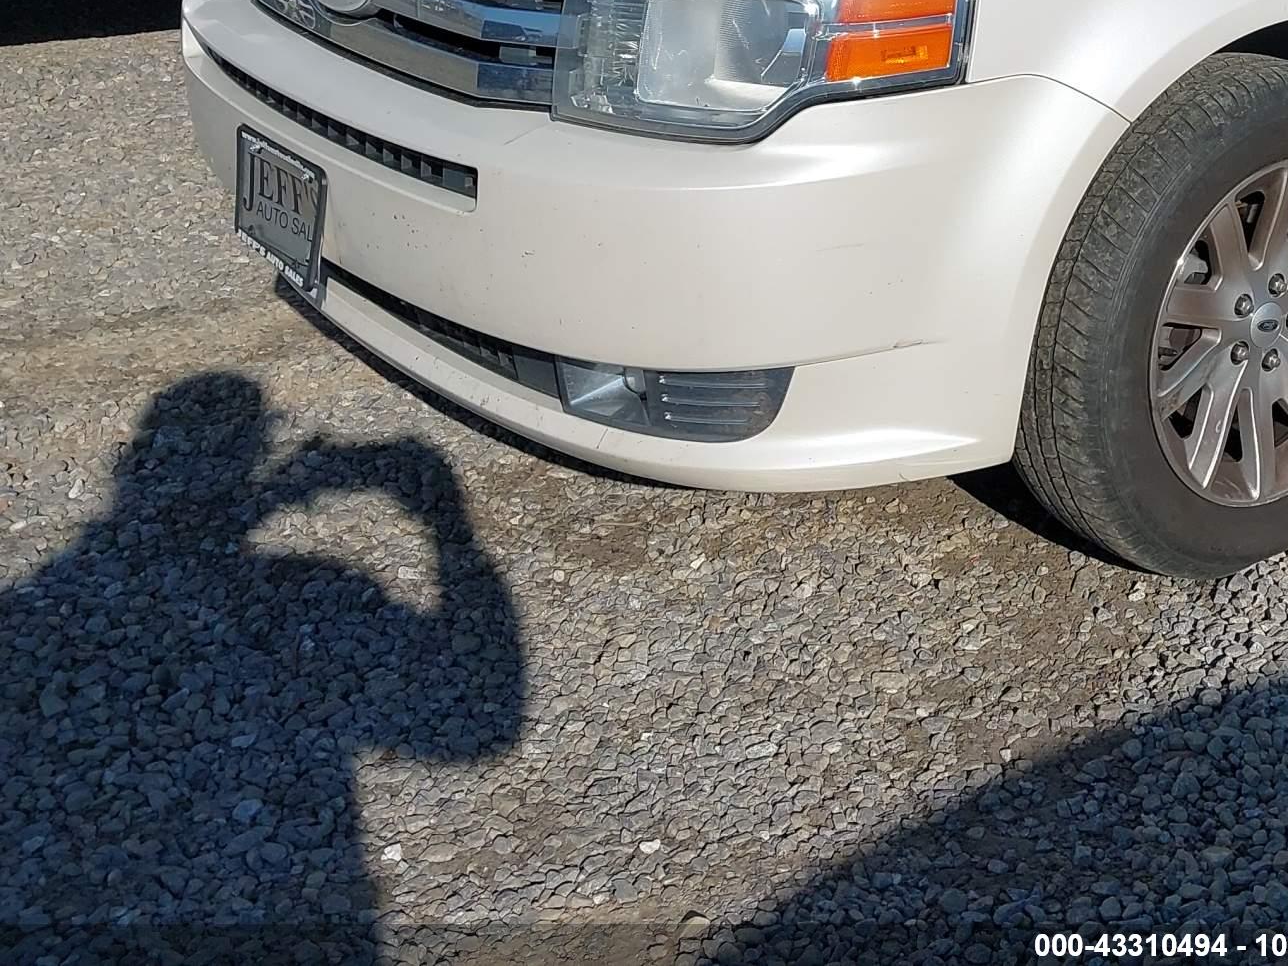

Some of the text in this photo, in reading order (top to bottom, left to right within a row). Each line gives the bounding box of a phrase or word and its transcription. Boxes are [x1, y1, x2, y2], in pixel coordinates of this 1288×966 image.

[256, 200, 289, 229] AUTO
[265, 251, 285, 271] AUTO
[284, 265, 304, 288] SALES
